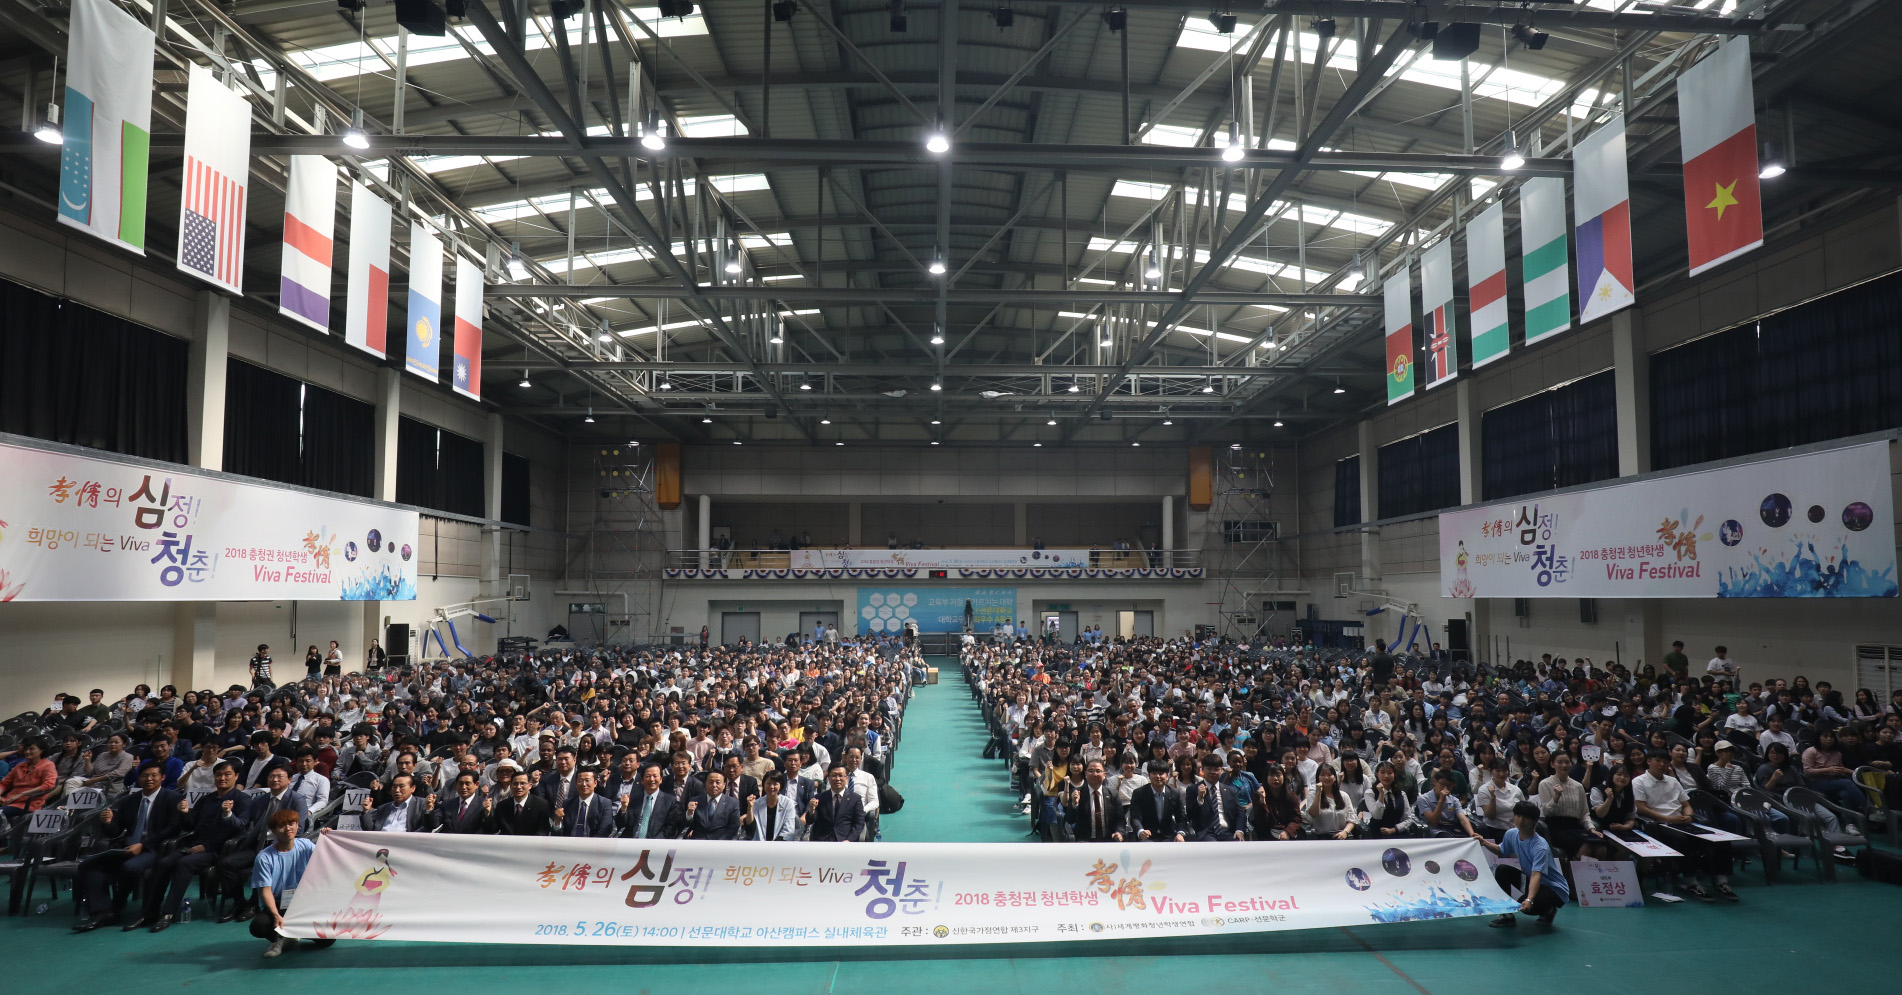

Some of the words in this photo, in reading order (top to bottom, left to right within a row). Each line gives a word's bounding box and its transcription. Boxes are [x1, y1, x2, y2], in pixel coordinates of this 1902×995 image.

[128, 475, 201, 529] 심정!
[1516, 504, 1558, 545] 심정!
[26, 527, 79, 549] 희망이
[83, 533, 115, 552] 되는
[120, 535, 150, 551] Viva
[150, 531, 219, 587] 청춘!
[225, 548, 246, 558] 2018
[249, 548, 274, 561] 충청권
[276, 549, 307, 563] 청년학생
[1580, 550, 1599, 560] 2018
[1601, 547, 1625, 560] 충청권
[1627, 543, 1664, 559] 청년학생
[254, 565, 281, 582] Viva
[285, 566, 331, 583] Festival
[1475, 552, 1495, 566] 희망이
[1497, 553, 1511, 565] 되는
[1513, 552, 1530, 562] Viva
[1531, 544, 1575, 587] 청춘!
[1606, 563, 1634, 580] Viva
[1639, 561, 1700, 579] Festival
[72, 791, 98, 805] VIP
[35, 814, 62, 828] VIP
[620, 849, 715, 908] 심정!
[723, 864, 773, 887] 희망이
[779, 866, 812, 887] 되는
[818, 868, 853, 884] Viva
[854, 859, 943, 919] 청춘!
[955, 892, 990, 906] 2018
[994, 890, 1037, 908] 충청권
[1040, 890, 1099, 907] 청년학생
[1151, 896, 1200, 914] Viva
[1208, 895, 1300, 913] Festival
[1591, 881, 1626, 895] 효정상
[534, 923, 569, 937] 2018.
[592, 921, 639, 938] 26(토)
[642, 926, 678, 938] 14:00
[688, 925, 753, 939] 선문대학교
[756, 926, 820, 939] 아산캠퍼스
[824, 926, 888, 939] 실내체육관
[1010, 925, 1039, 934] 제3지구
